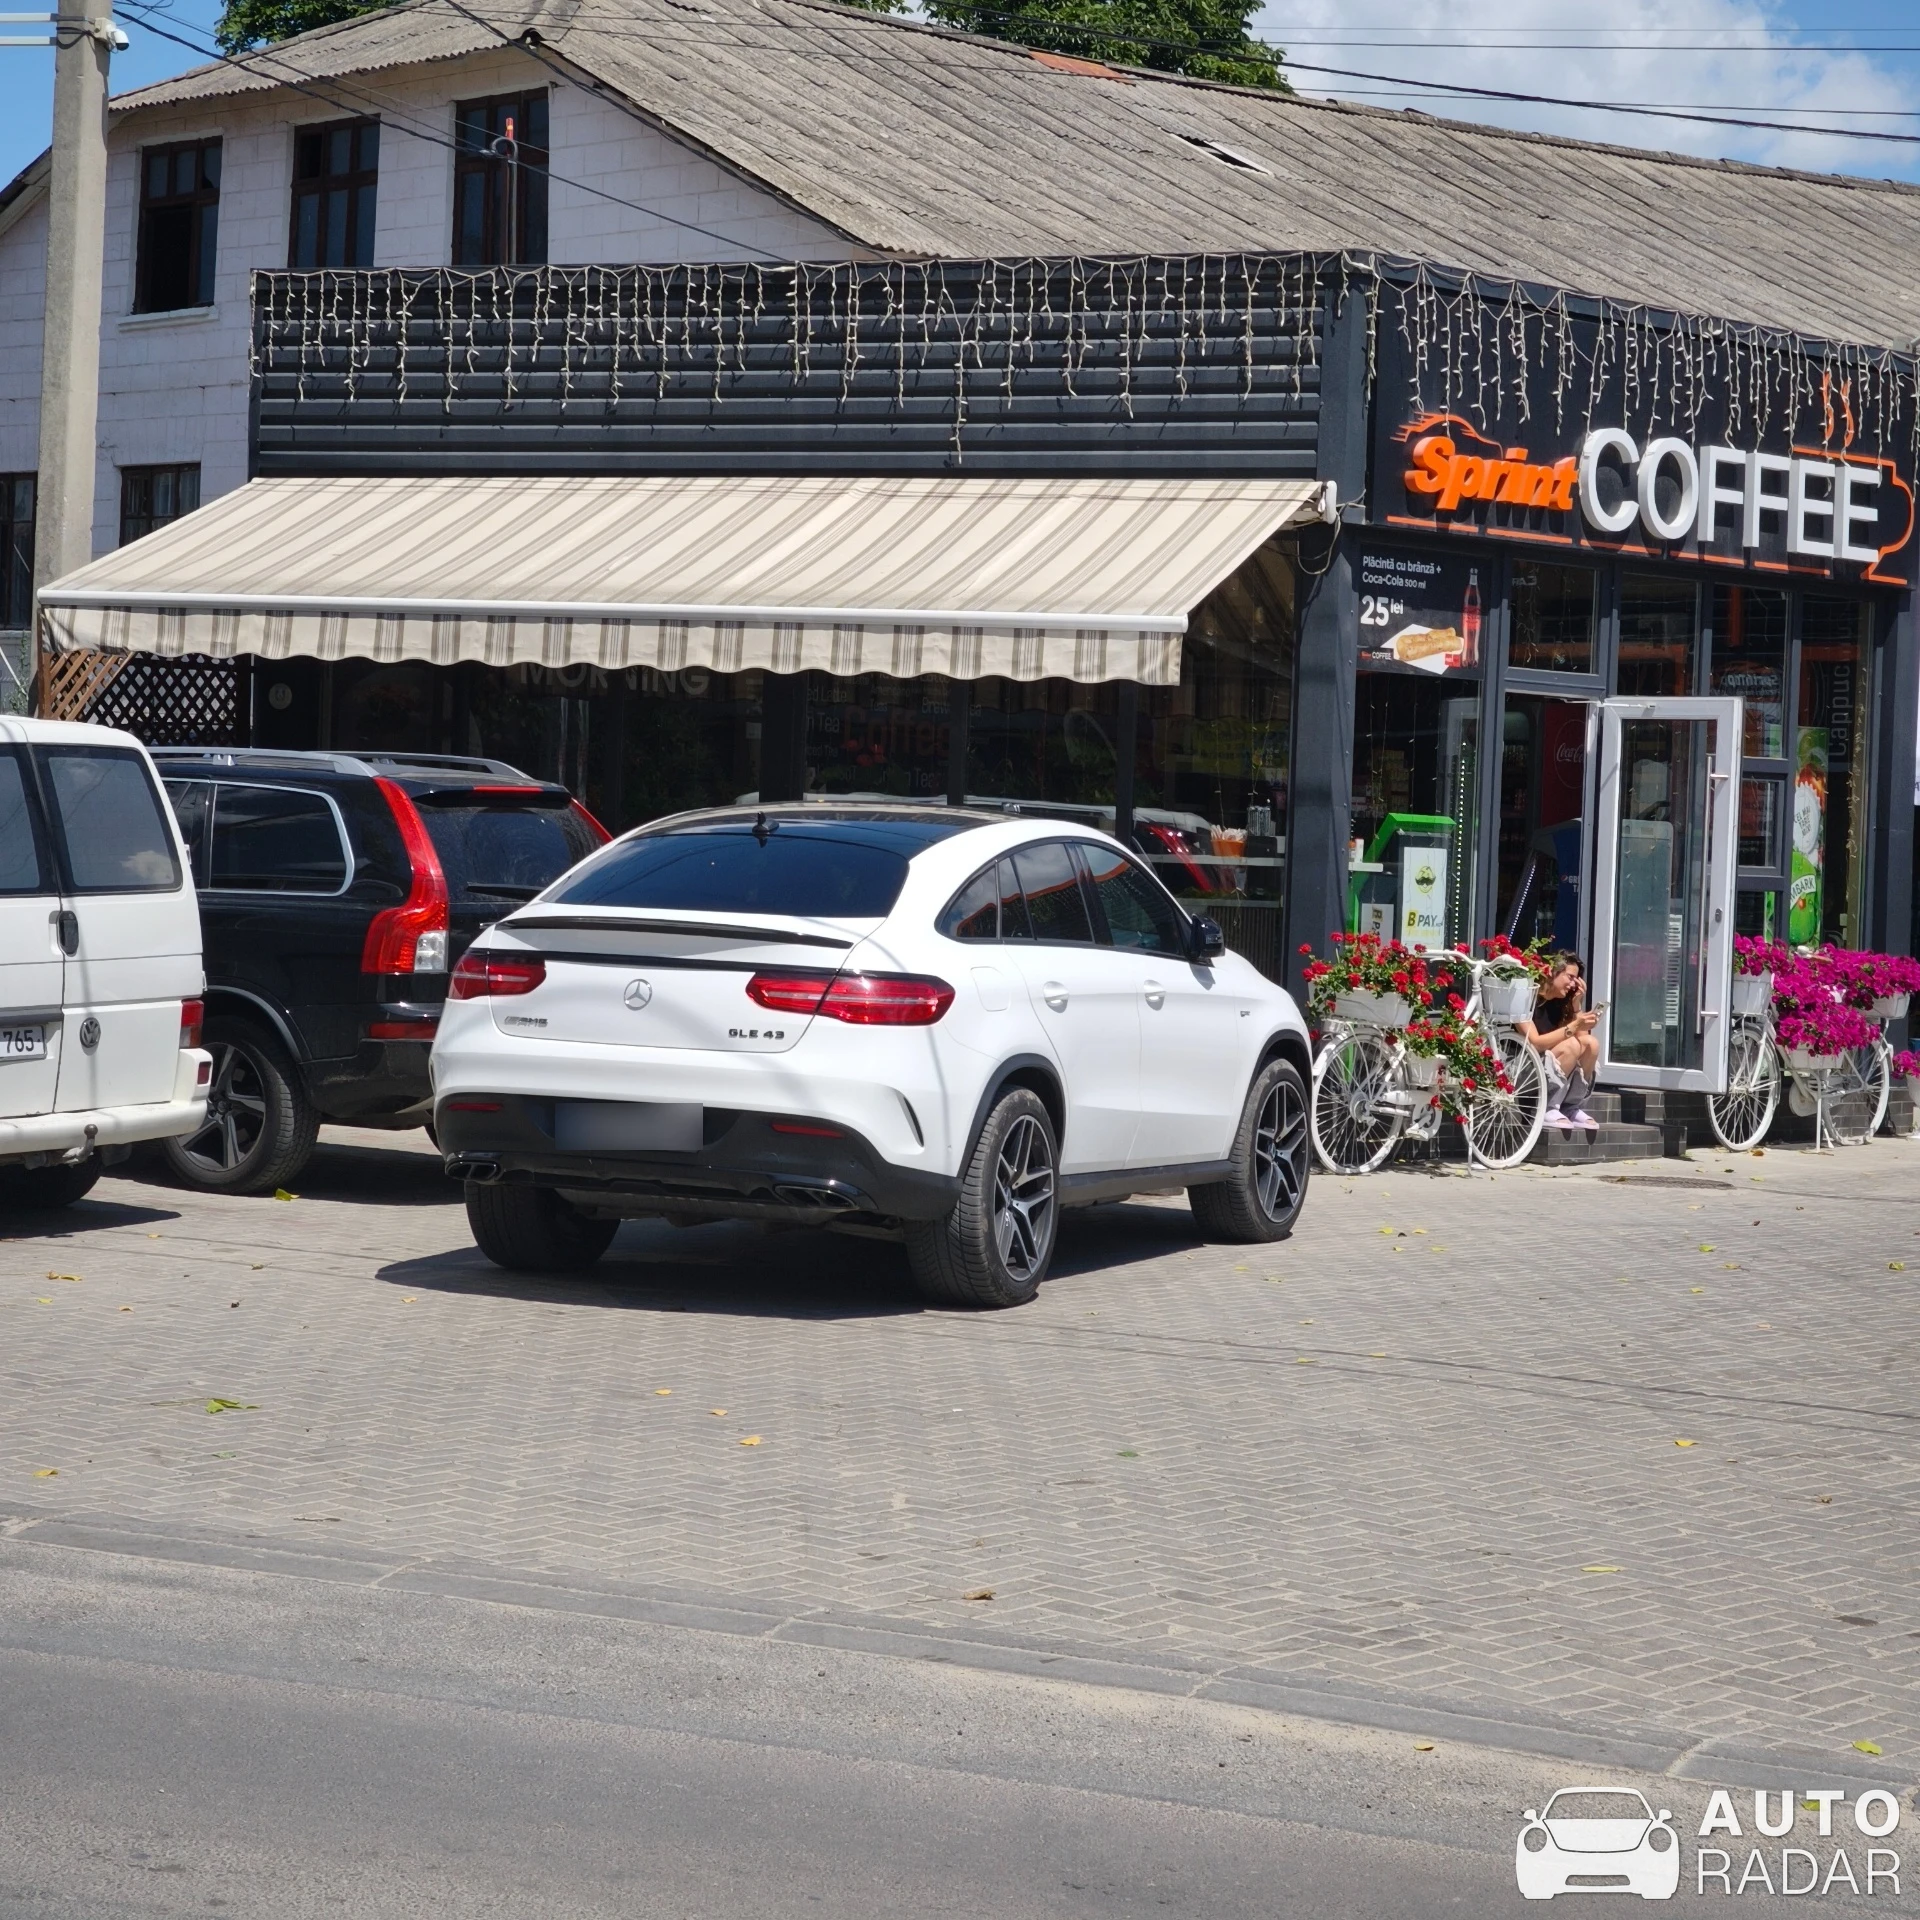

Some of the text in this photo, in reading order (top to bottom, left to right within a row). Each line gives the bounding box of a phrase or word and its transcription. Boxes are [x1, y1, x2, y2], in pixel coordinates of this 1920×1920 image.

[1405, 428, 1880, 563] Sprint COFFEE
[1363, 556, 1394, 570] Plăcintă
[1396, 562, 1406, 571] cu
[1408, 560, 1435, 574] brânză
[1362, 572, 1426, 589] Coca-Cola 500 ml
[1360, 594, 1404, 627] 25 lei
[1372, 651, 1391, 660] COFFEE
[1826, 663, 1854, 757] Cappuc
[1790, 876, 1815, 902] MBARK
[3, 1030, 34, 1053] 765
[728, 1028, 785, 1040] GLE 43
